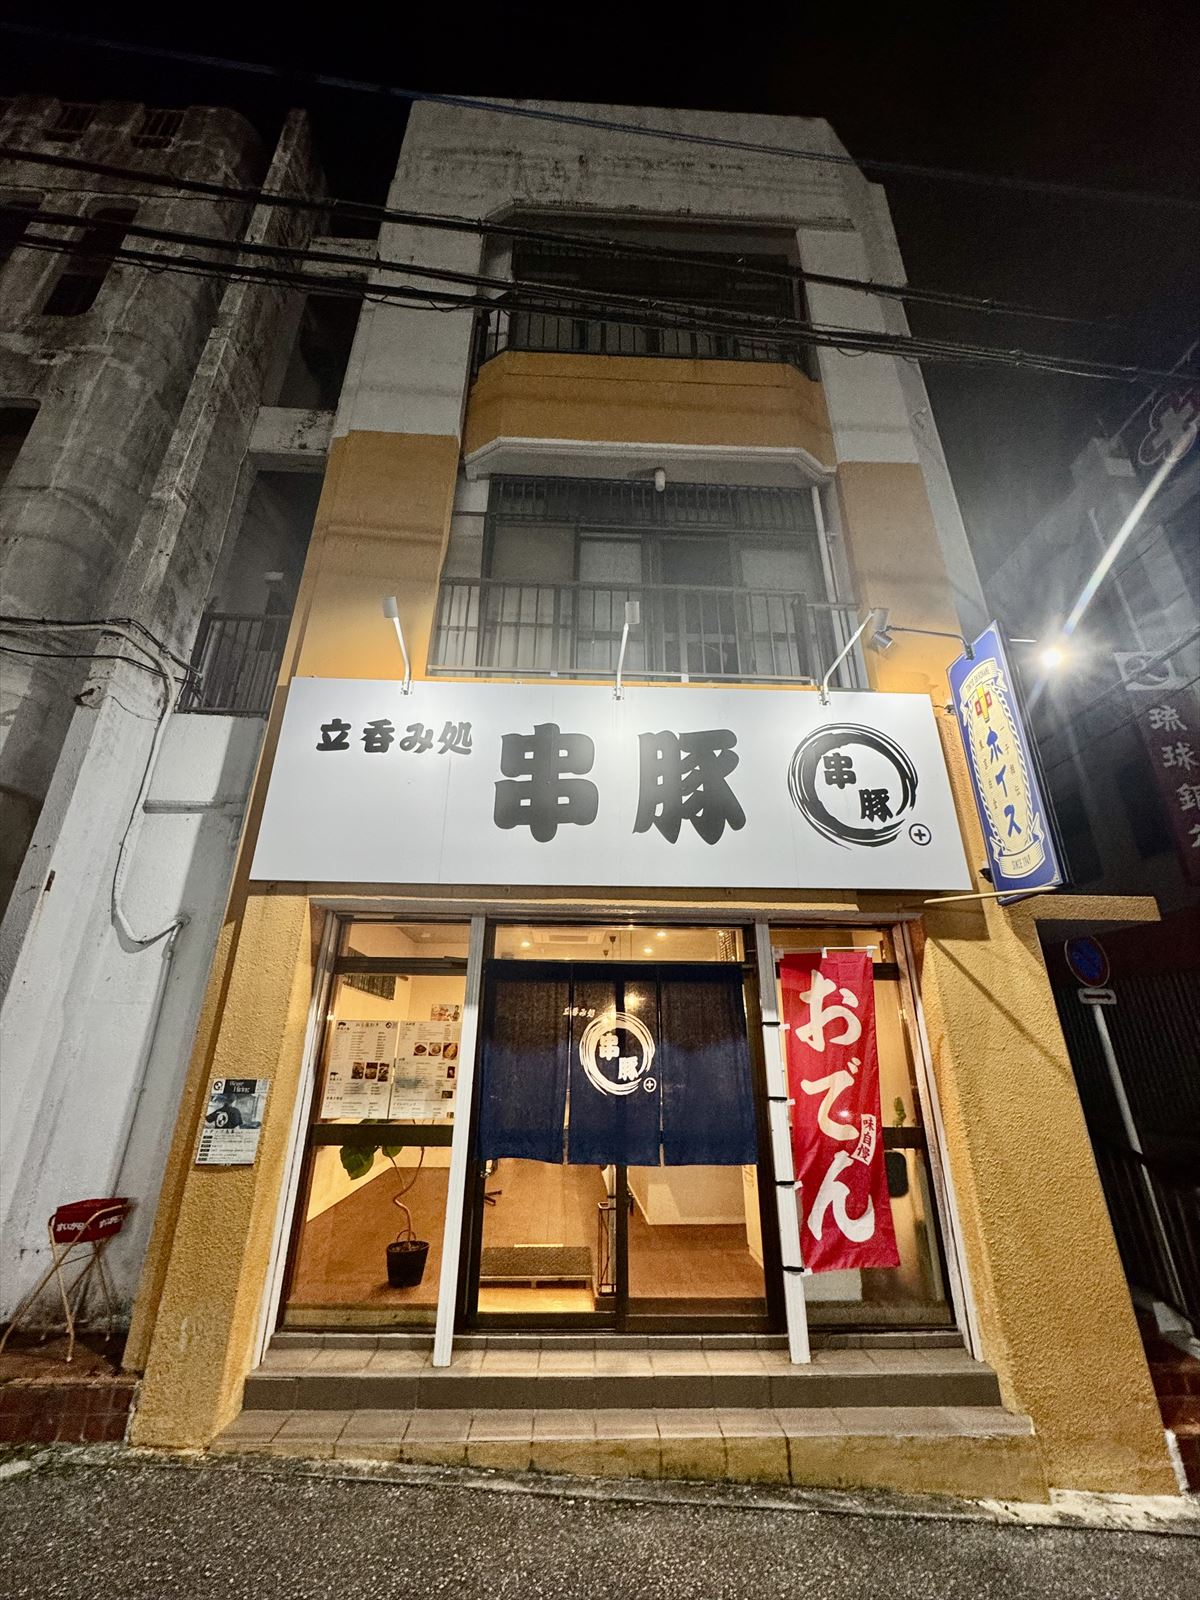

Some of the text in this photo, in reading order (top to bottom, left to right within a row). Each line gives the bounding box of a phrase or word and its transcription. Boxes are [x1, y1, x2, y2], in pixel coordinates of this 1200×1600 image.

[316, 718, 473, 756] 立呑み処
[494, 722, 747, 844] 串豚
[822, 752, 894, 823] 串豚
[795, 968, 875, 1243] おでん
[857, 1116, 875, 1163] 味自慢
